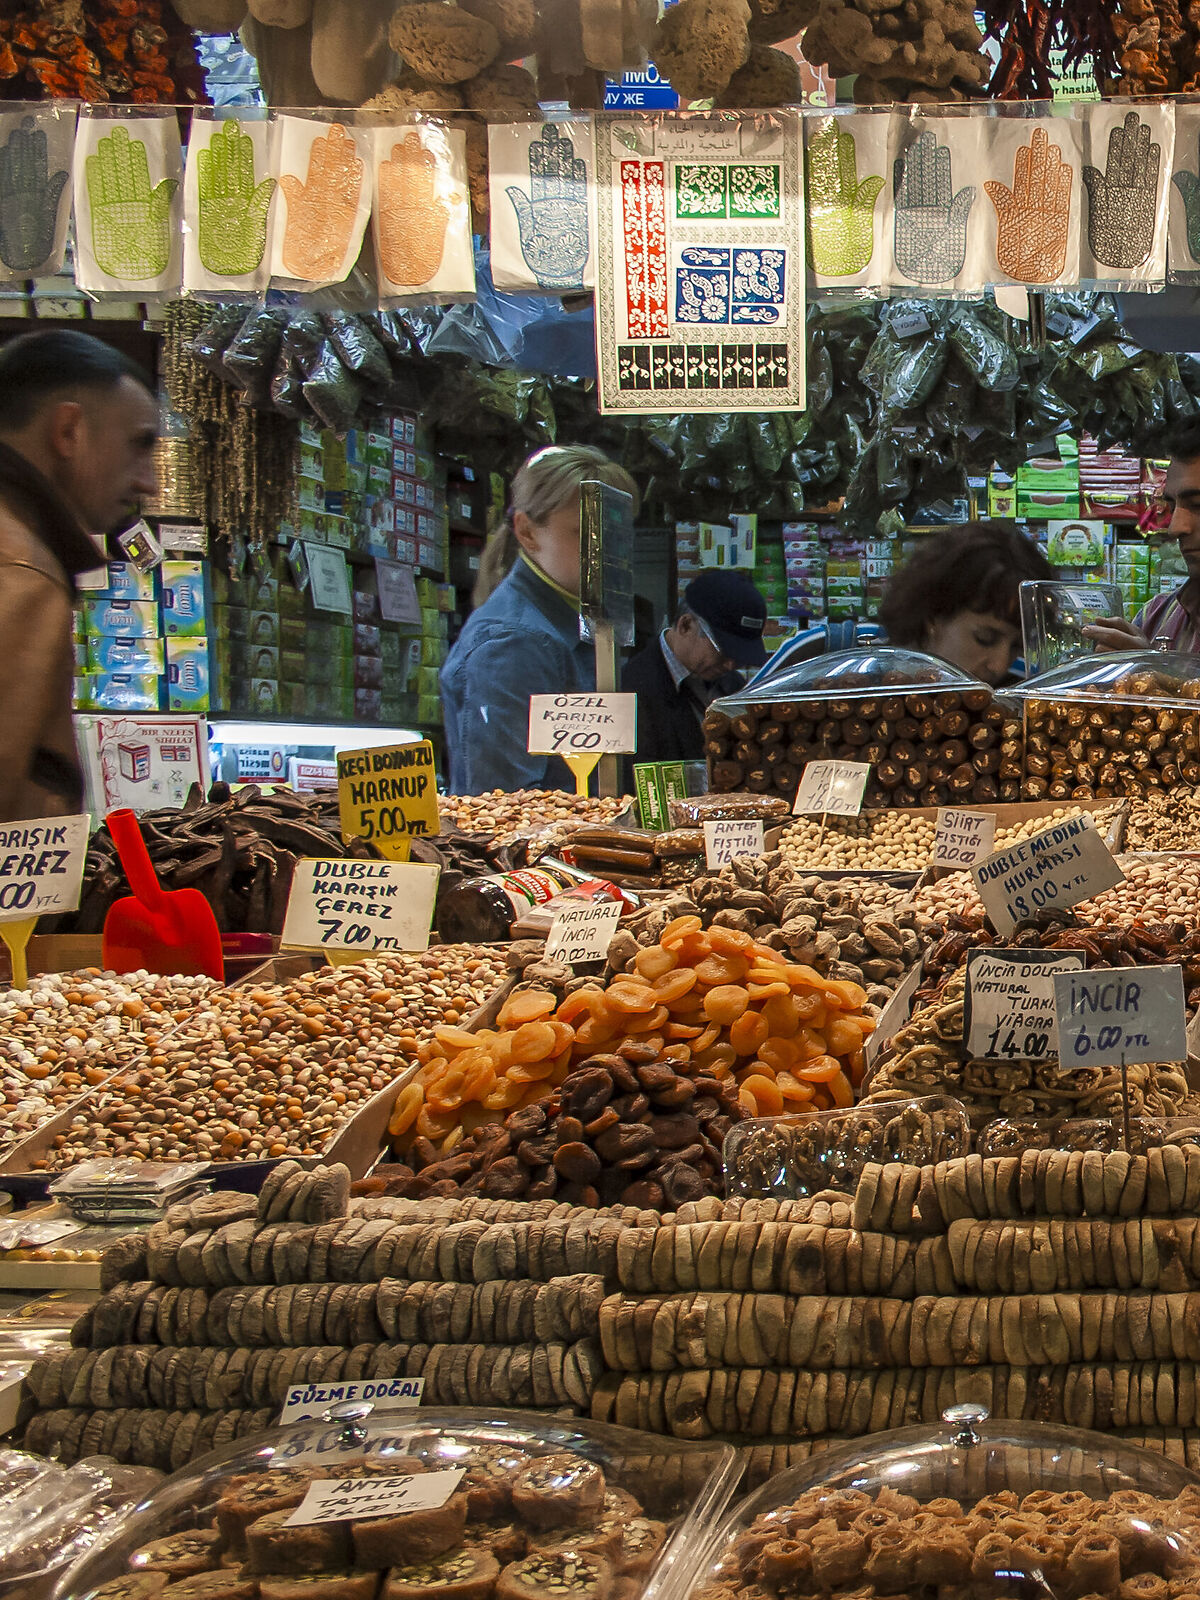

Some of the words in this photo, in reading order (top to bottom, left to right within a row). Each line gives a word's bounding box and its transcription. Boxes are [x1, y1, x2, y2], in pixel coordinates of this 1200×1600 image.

[622, 94, 645, 105] ЖЕ
[554, 693, 608, 708] ÖZEL
[543, 710, 615, 724] KARIŞIK
[161, 728, 195, 737] NEFES
[339, 751, 371, 779] KEÇİ
[350, 774, 428, 805] HARNUP
[358, 806, 406, 840] 5.00
[714, 822, 758, 834] ANTEP
[0, 826, 68, 851] ARIŞIK
[713, 835, 757, 849] FISTIĞI
[935, 830, 982, 847] FISTIĞI
[0, 850, 71, 876] EREZ
[936, 845, 976, 864] 20.00
[312, 861, 391, 879] DUBLE
[977, 846, 1028, 885] DUBLE
[1004, 843, 1082, 895] HURMASI
[312, 879, 398, 900] KARIŞIK
[1062, 873, 1089, 890] YTL
[36, 893, 64, 909] YTL
[315, 898, 393, 919] ÇEREZ
[559, 905, 619, 924] NATURAL
[318, 919, 371, 945] 7.00
[561, 926, 597, 943] İNCİR
[976, 959, 1015, 978] İNCİR
[973, 981, 1030, 995] NATURAL
[1071, 977, 1141, 1016] İNCİR
[1074, 1024, 1122, 1057] 6.00
[1124, 1034, 1150, 1048] YTL
[287, 1383, 359, 1406] SÜZME
[362, 1379, 421, 1399] DOĞAL
[330, 1476, 415, 1495] ANTEP
[316, 1489, 409, 1508] TATLISI
